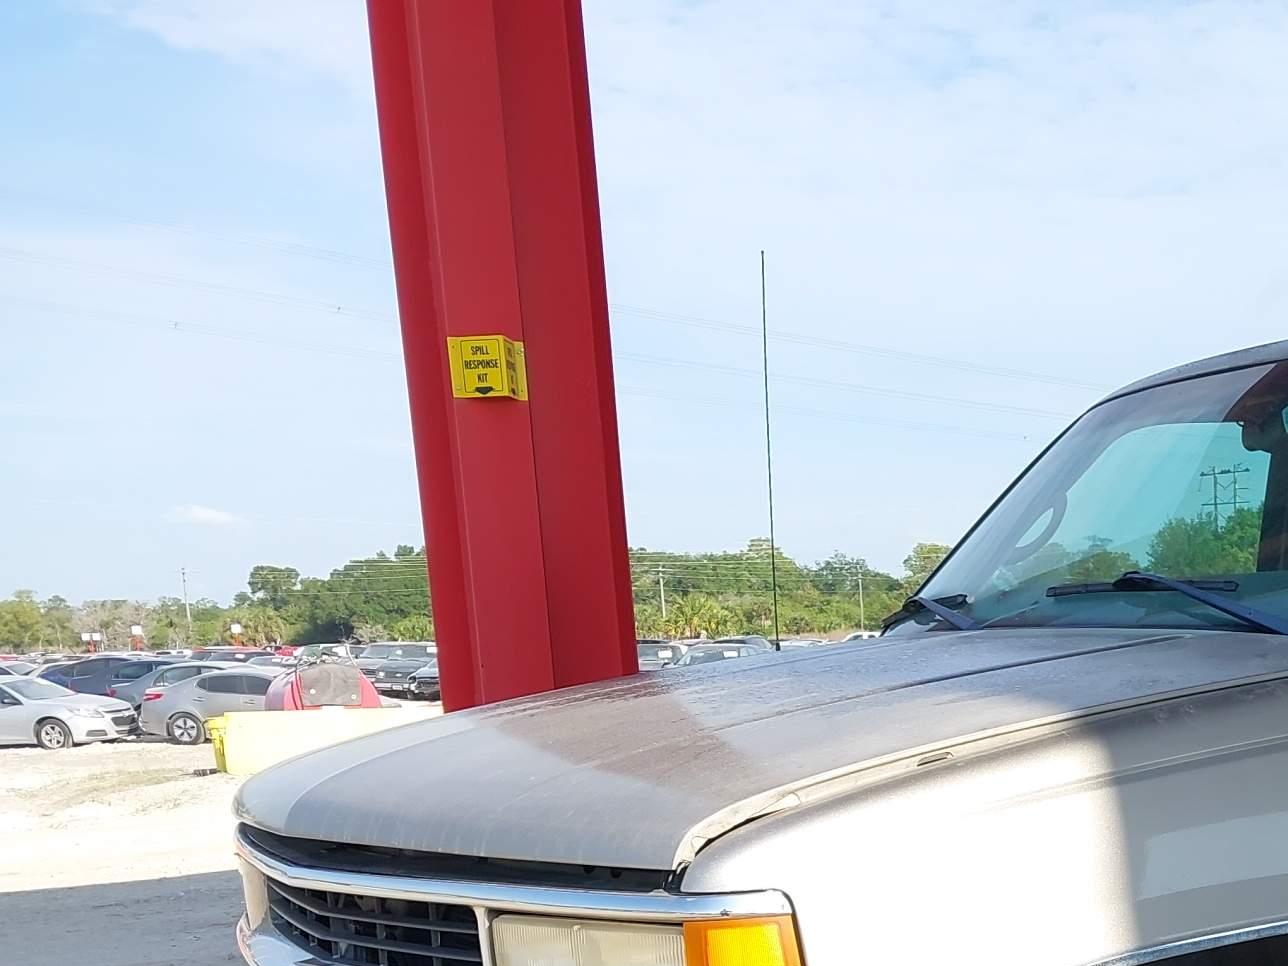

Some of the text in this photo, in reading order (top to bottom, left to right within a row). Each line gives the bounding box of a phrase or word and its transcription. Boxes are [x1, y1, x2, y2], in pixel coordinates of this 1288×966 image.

[470, 345, 490, 355] SPILL
[464, 359, 499, 369] RESPONSE
[477, 373, 488, 383] KIT
